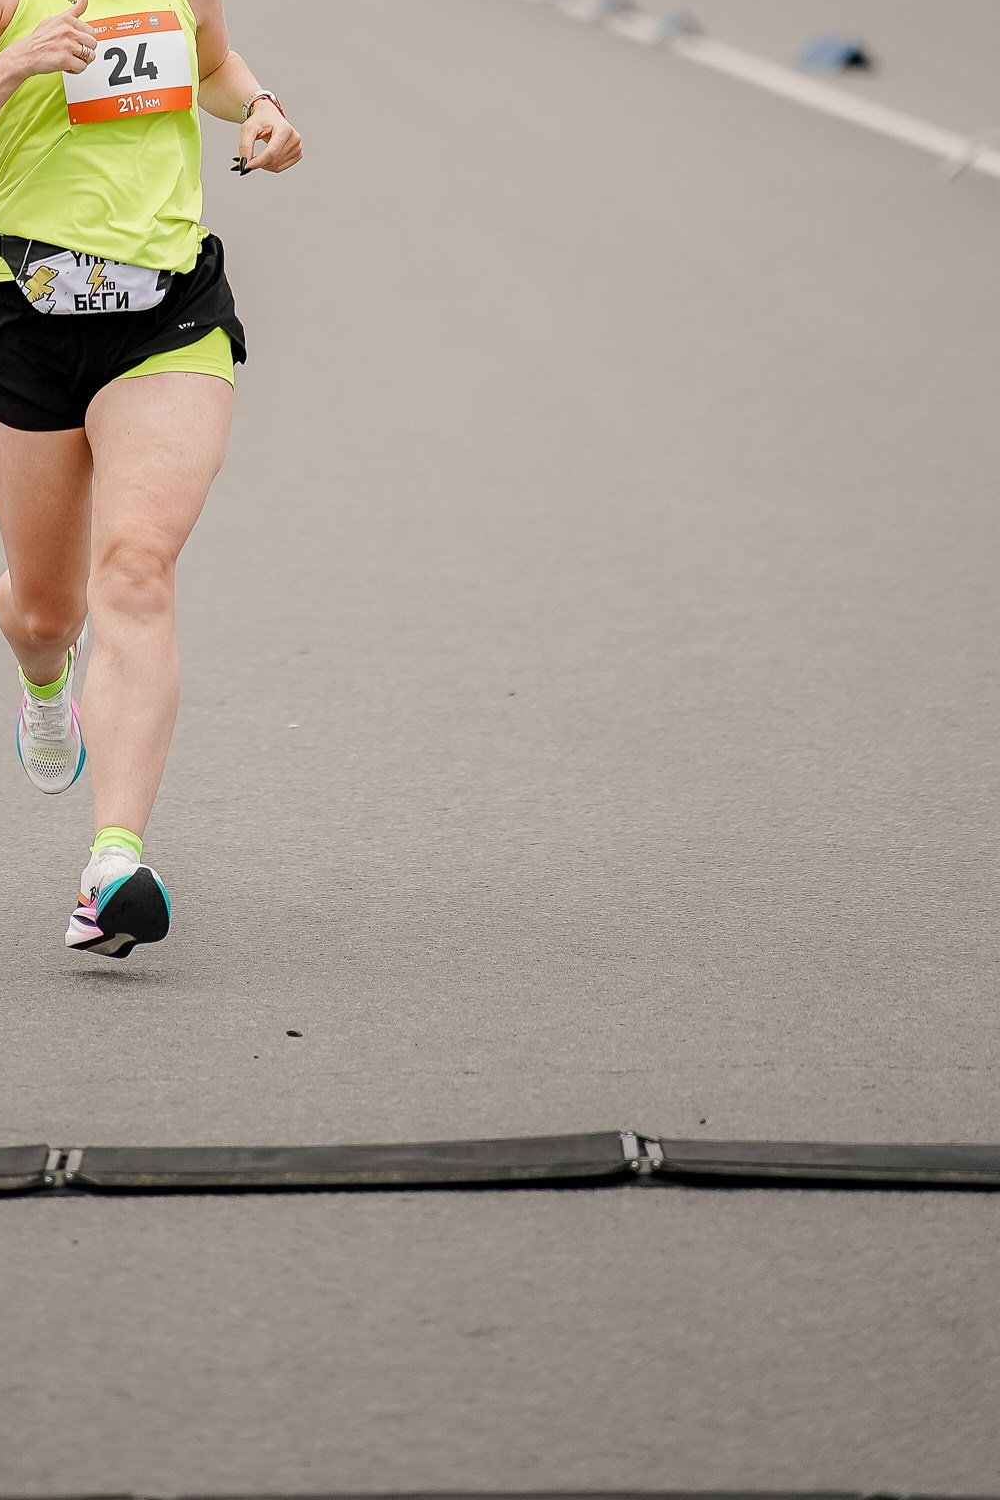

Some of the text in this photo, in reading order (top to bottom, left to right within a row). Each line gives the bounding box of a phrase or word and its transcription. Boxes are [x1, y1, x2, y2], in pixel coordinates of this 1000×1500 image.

[103, 42, 159, 87] 24
[117, 94, 144, 113] 21,1
[73, 291, 130, 311] БЕГИ
